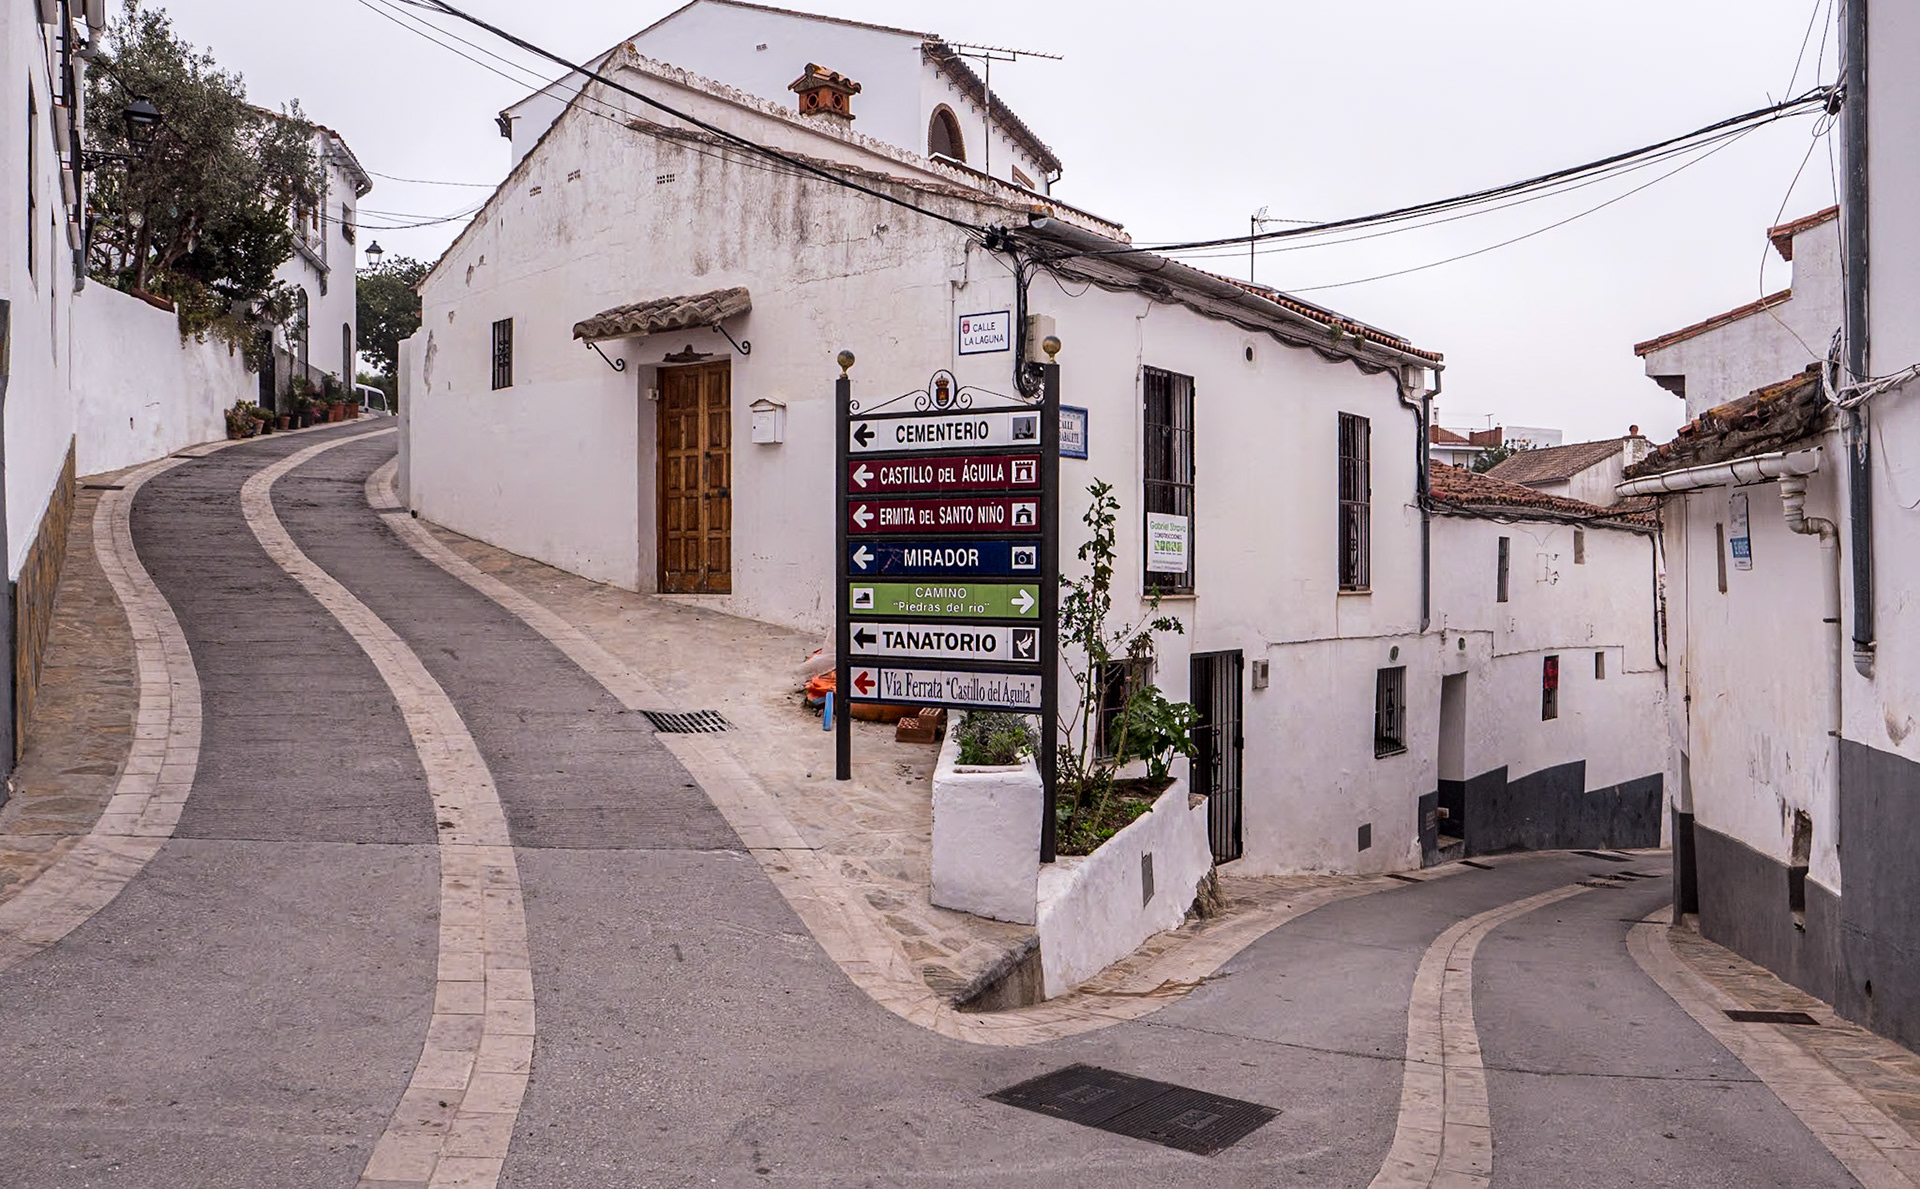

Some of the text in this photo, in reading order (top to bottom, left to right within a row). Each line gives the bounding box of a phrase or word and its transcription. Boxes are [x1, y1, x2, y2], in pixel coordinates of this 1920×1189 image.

[973, 322, 996, 333] CALLE
[964, 334, 1004, 346] LA LAGUNA
[896, 421, 989, 443] CEMENTERIO
[880, 459, 1004, 485] CASTILLO DEL ÁGUILA
[880, 501, 1005, 525] ERMITA DEL SANTO NIÑO
[904, 548, 979, 567] MIRADOR
[915, 587, 967, 599] CAMINO
[946, 602, 964, 612] del
[882, 631, 996, 652] TANATORIO
[884, 672, 902, 697] Vía
[905, 672, 943, 699] Ferrata
[987, 681, 1000, 702] del
